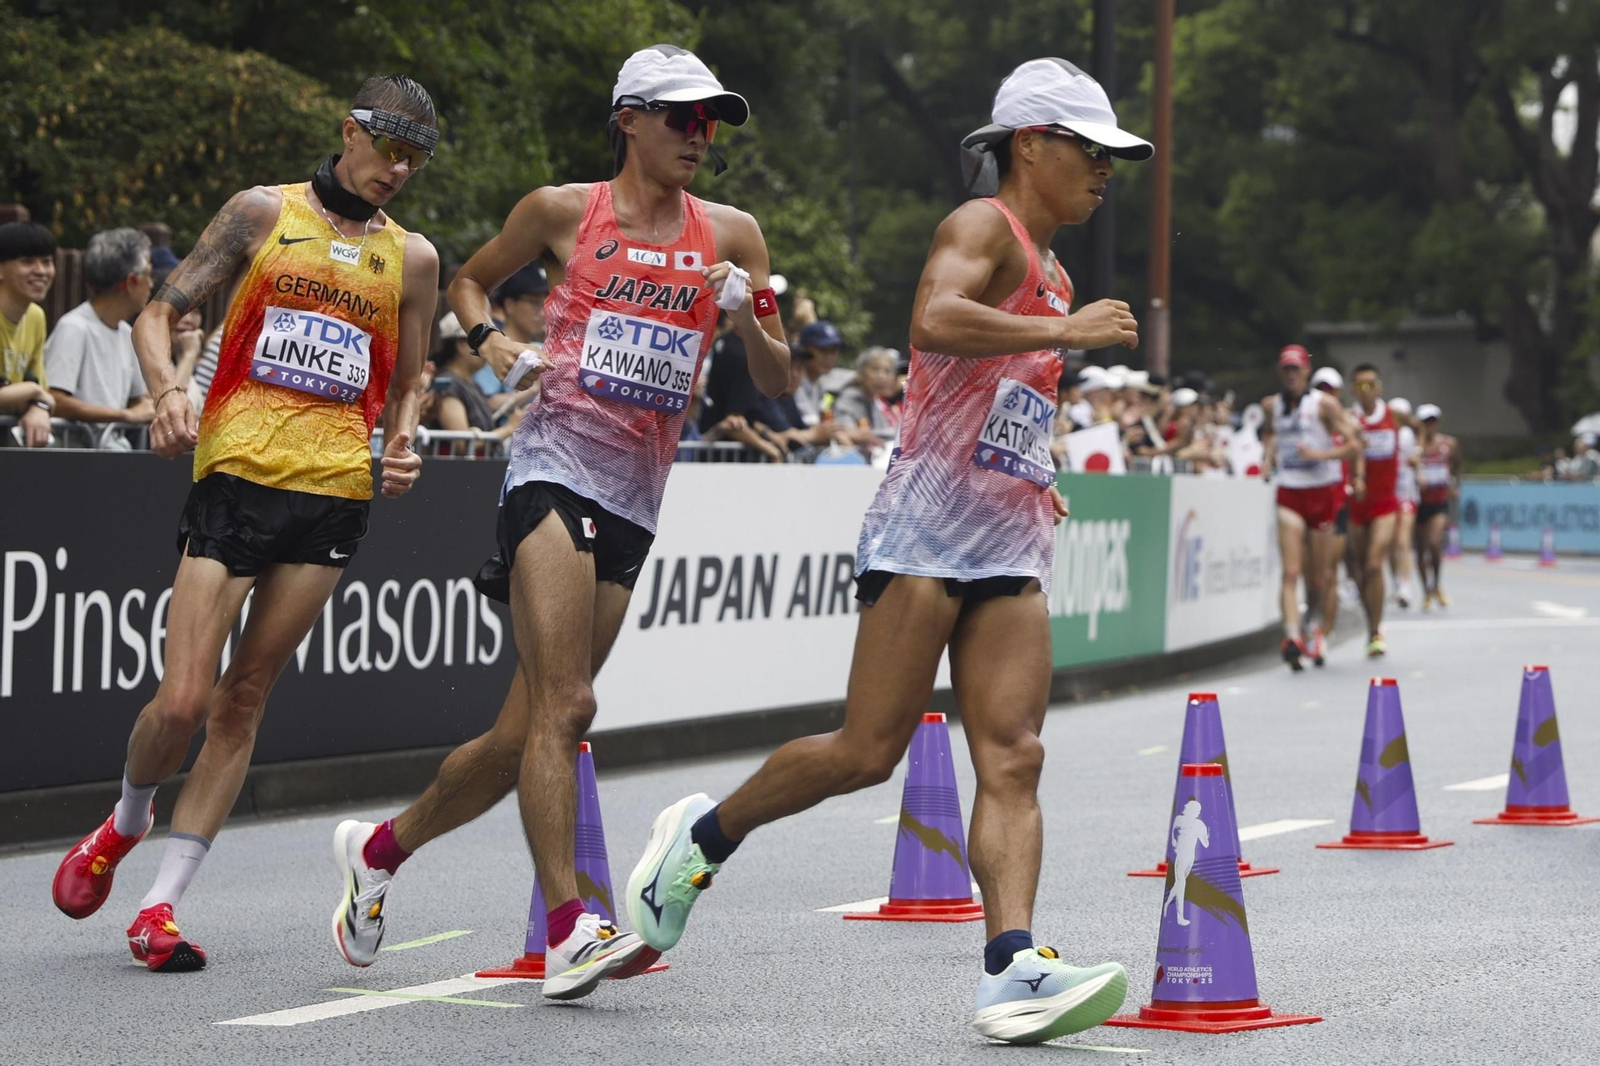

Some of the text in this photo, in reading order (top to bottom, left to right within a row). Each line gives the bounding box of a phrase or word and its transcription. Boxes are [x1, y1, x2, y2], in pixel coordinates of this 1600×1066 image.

[629, 251, 664, 265] ACN
[275, 274, 380, 321] GERMANY
[595, 275, 699, 313] JAPAN
[298, 315, 364, 355] TDK
[625, 319, 696, 358] TDK
[261, 336, 366, 385] LINKE 339
[586, 344, 691, 392] KAWANO 355
[1020, 387, 1055, 434] TDK
[638, 553, 861, 630] JAPAN AIR
[0, 547, 255, 698] Pinse
